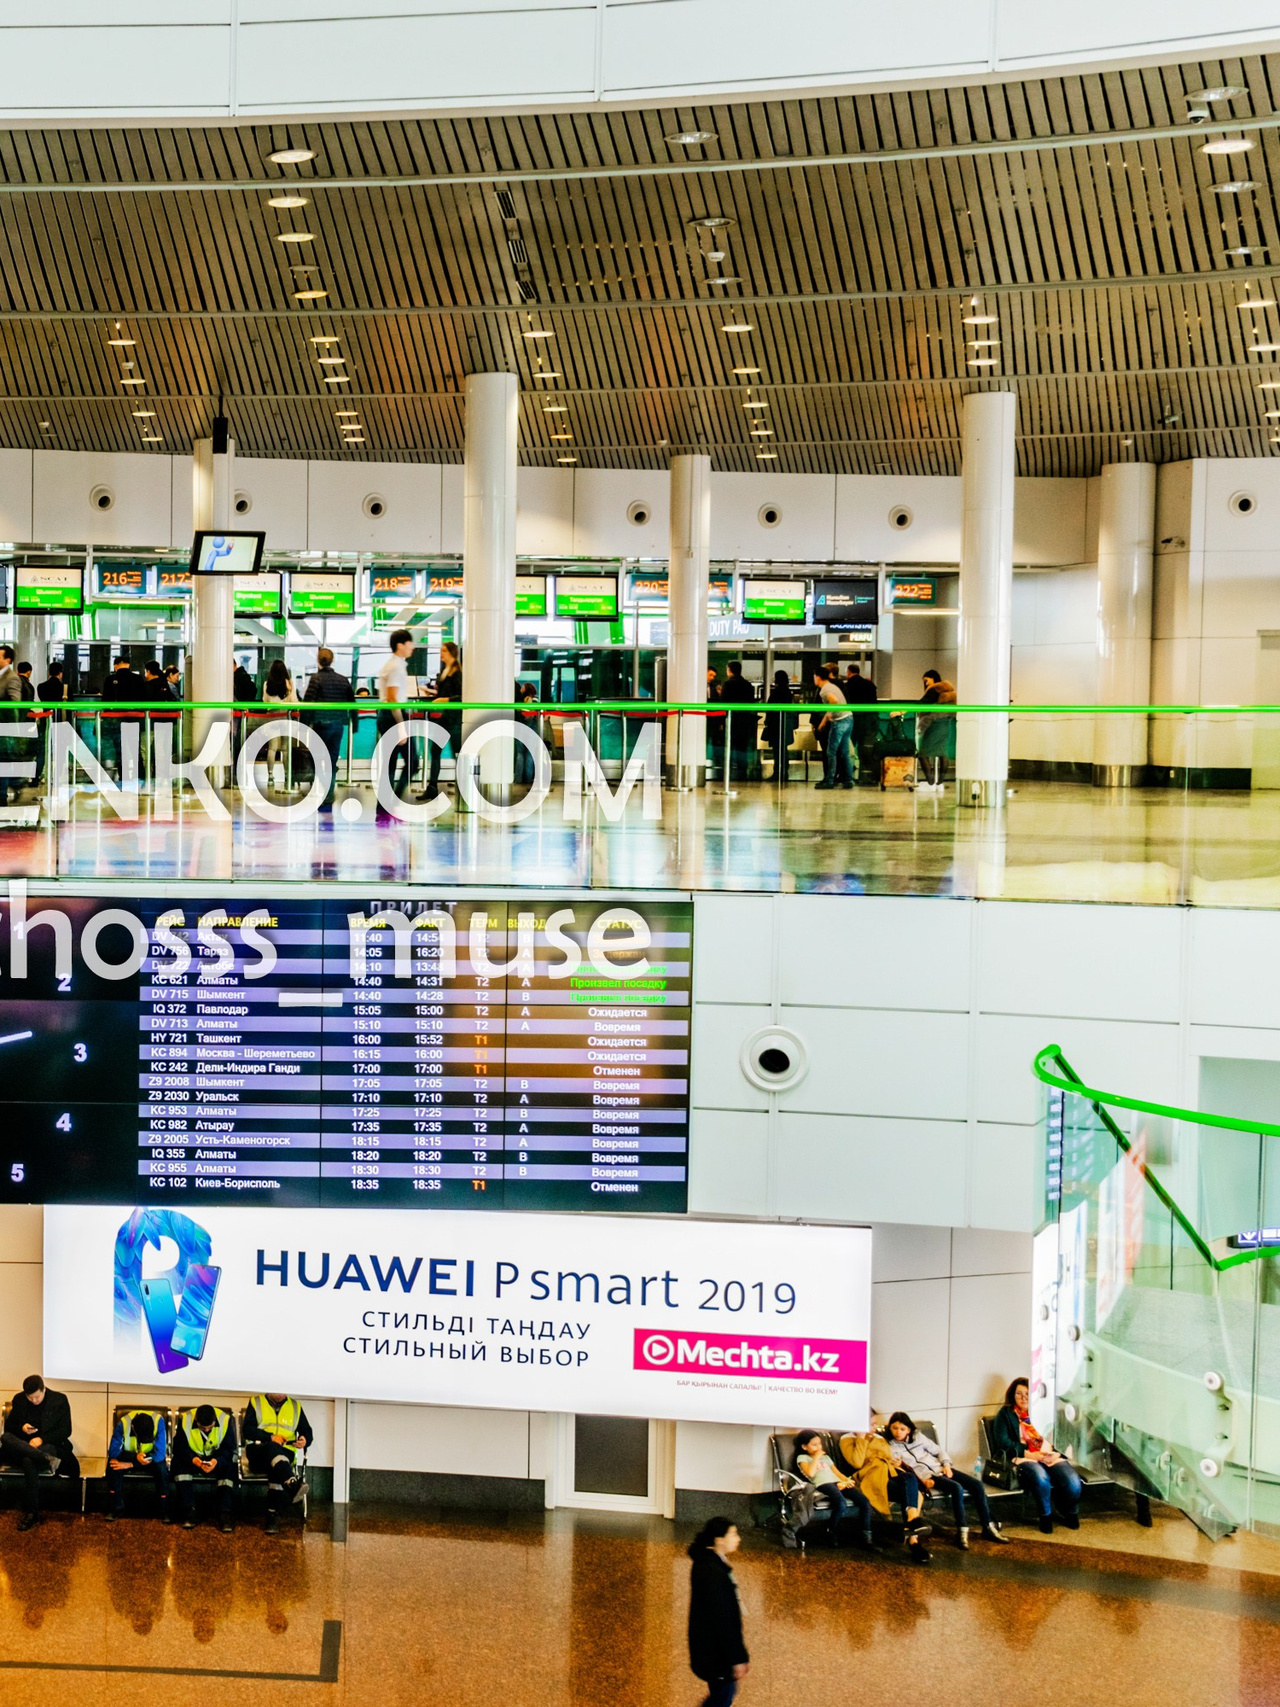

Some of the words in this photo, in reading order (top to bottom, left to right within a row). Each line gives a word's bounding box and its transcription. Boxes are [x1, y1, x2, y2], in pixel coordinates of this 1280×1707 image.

[102, 572, 128, 585] 216
[160, 573, 185, 586] 217
[374, 578, 398, 591] 218
[430, 578, 454, 590] 219
[635, 581, 658, 593] 220
[894, 584, 919, 597] 222
[710, 620, 730, 636] DUTY
[58, 974, 71, 992] 2
[167, 1005, 186, 1014] 372
[197, 1005, 248, 1015] Павлодар
[353, 1005, 381, 1015] 15:05
[415, 1006, 443, 1016] 15:00
[588, 1007, 647, 1018] Ожидается
[74, 1043, 87, 1062] 3
[169, 1063, 187, 1072] 242
[196, 1063, 266, 1074] Дели-Индира
[269, 1064, 300, 1074] Ганди
[352, 1064, 380, 1074] 17:00
[414, 1064, 442, 1074] 17:00
[593, 1066, 640, 1076] Отменен
[56, 1113, 72, 1132] 4
[148, 1135, 161, 1144] Z9
[164, 1135, 189, 1144] 2005
[195, 1135, 291, 1146] Усть-Каменогорск
[351, 1136, 379, 1146] 18:15
[413, 1137, 441, 1147] 18:15
[592, 1139, 639, 1149] Вовремя
[11, 1164, 24, 1182] 5
[168, 1178, 186, 1187] 102
[195, 1178, 280, 1189] Киев-Борисполь
[351, 1180, 379, 1189] 18:35
[413, 1180, 441, 1190] 18:35
[591, 1182, 638, 1192] Отменен
[257, 1249, 474, 1297] HUAWEI
[496, 1261, 519, 1298] P
[530, 1268, 678, 1309] smart
[698, 1279, 797, 1315] 2019
[362, 1311, 473, 1335] СТИЛЬДІ
[486, 1318, 590, 1341] ТАҢДАУ
[343, 1337, 487, 1362] СТИЛЬНЫЙ
[500, 1347, 589, 1367] ВЫБОР
[677, 1339, 839, 1373] Mechta.kz
